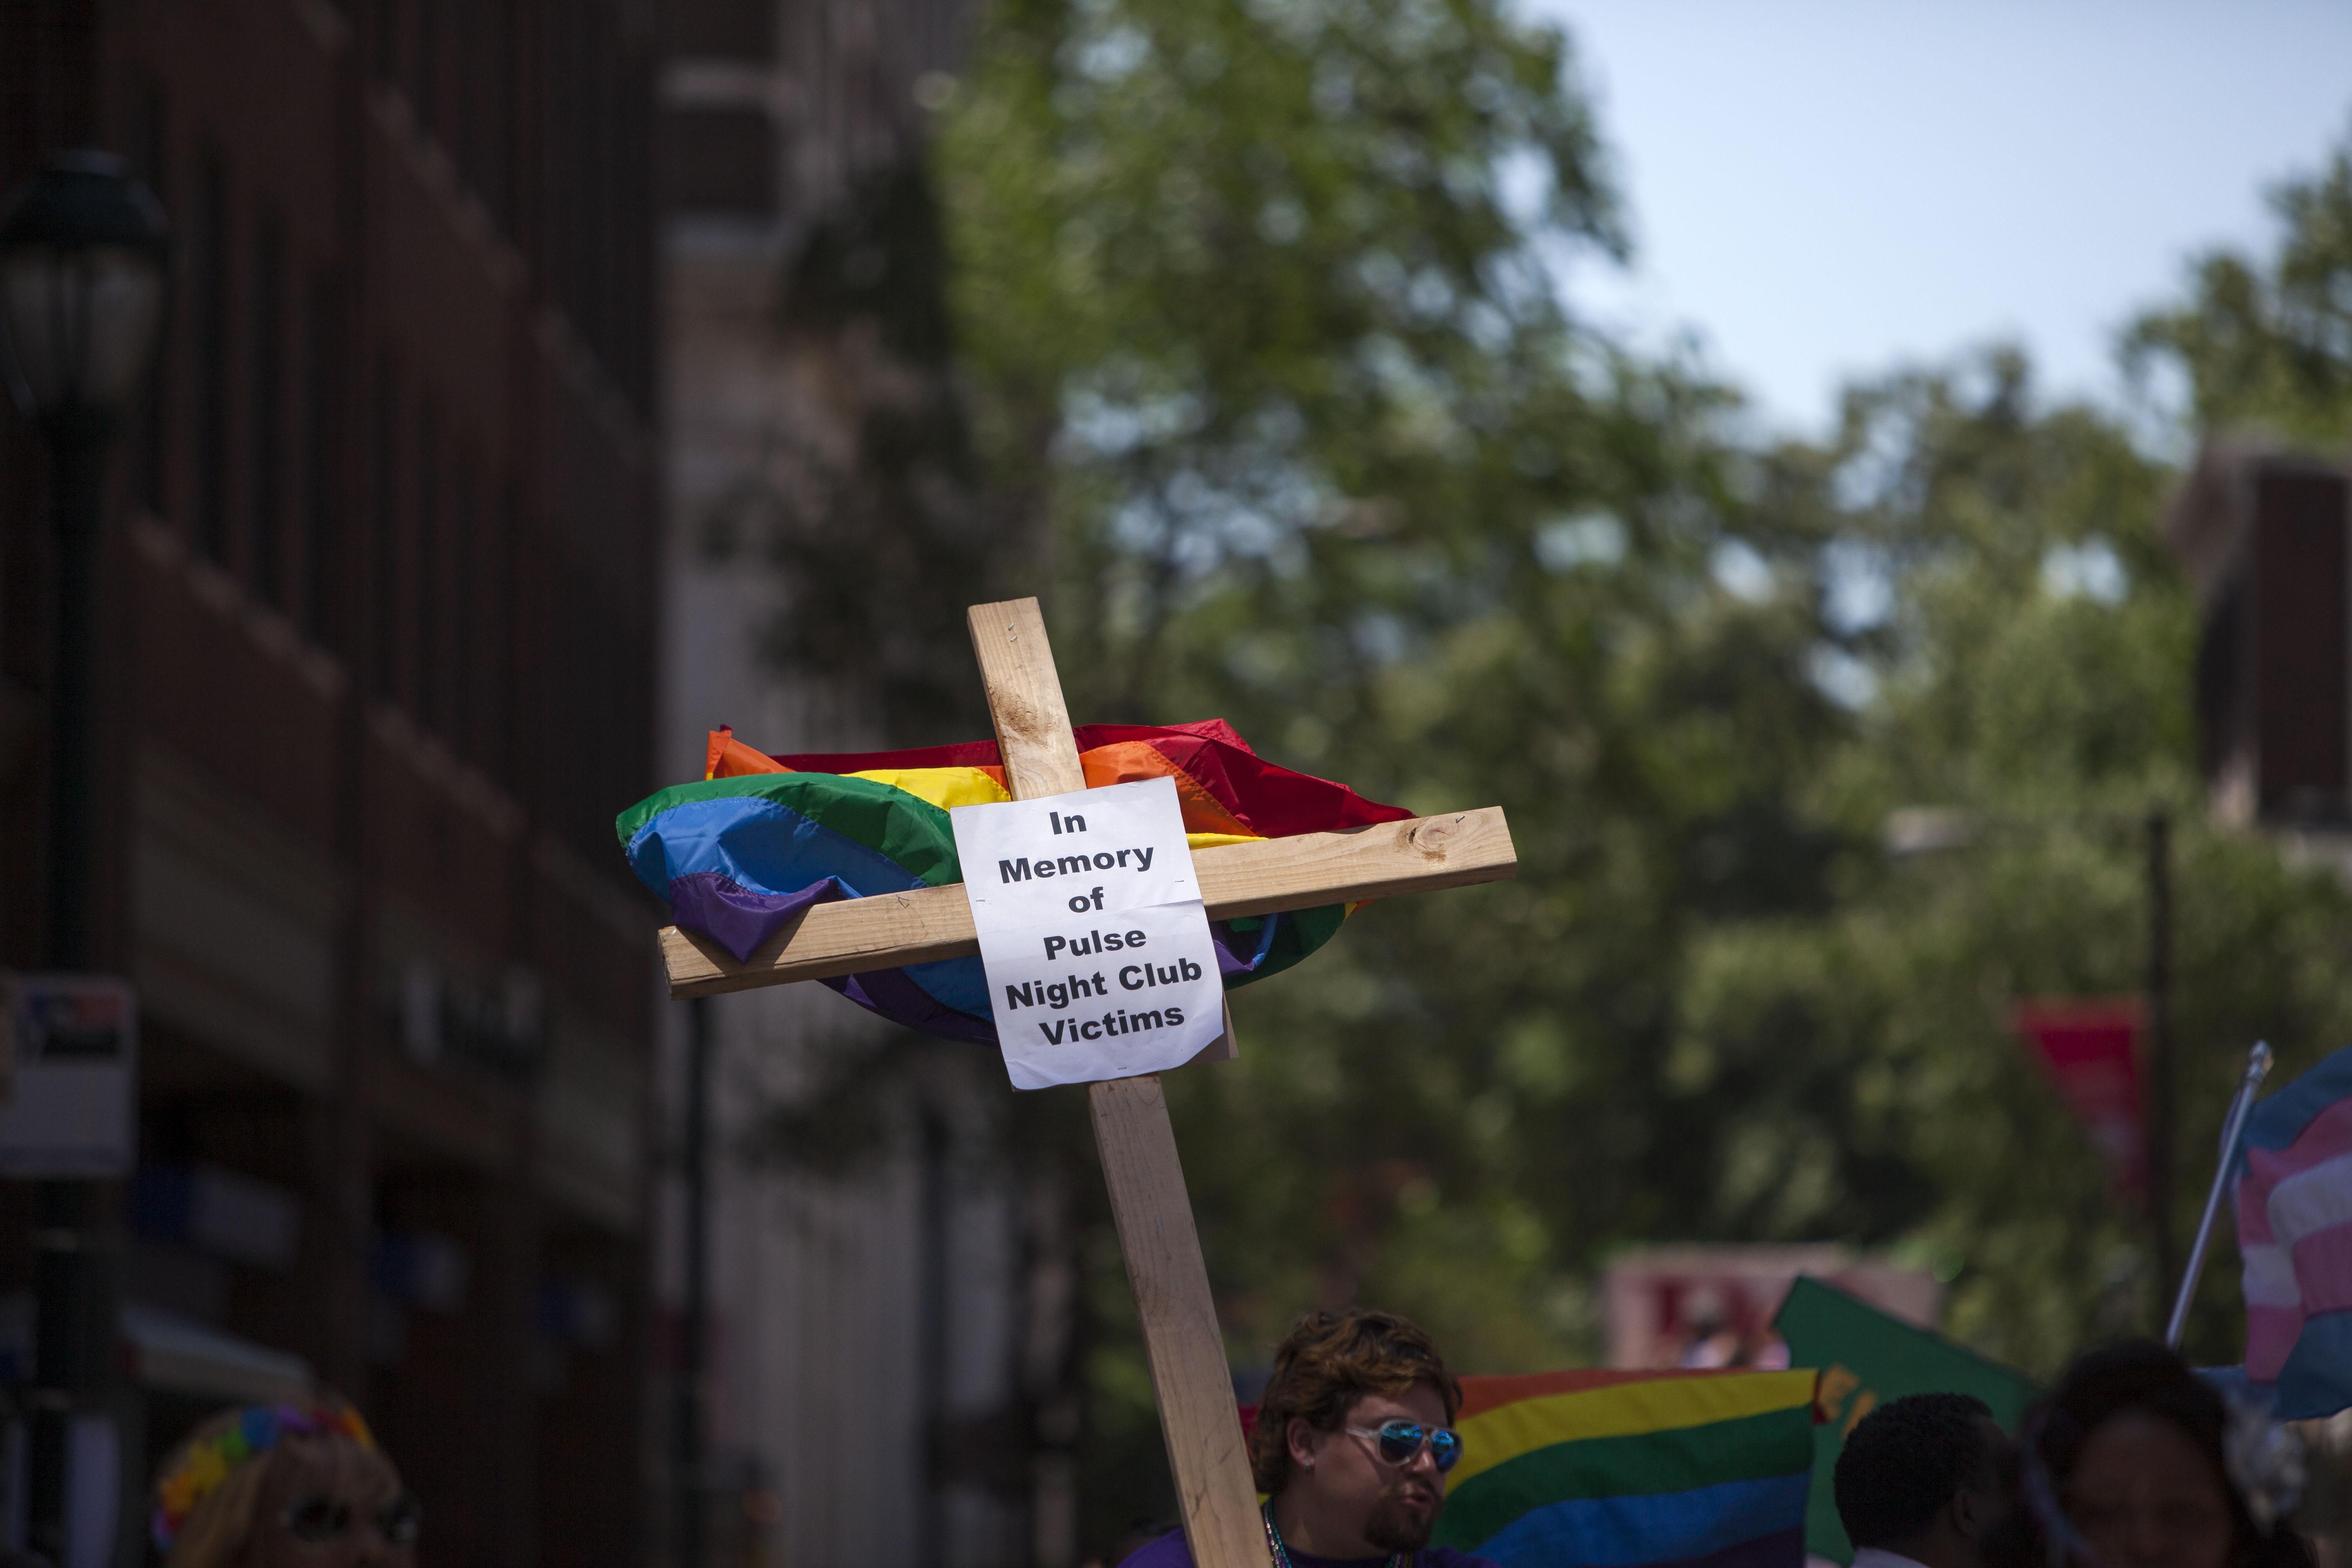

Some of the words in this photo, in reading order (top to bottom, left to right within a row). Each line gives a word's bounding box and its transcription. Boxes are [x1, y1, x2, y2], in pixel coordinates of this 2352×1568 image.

[1050, 812, 1087, 835] In
[998, 847, 1153, 884] Memory
[1068, 887, 1104, 913] of
[1043, 930, 1146, 961] Pulse
[1005, 971, 1108, 1011] Night
[1119, 958, 1202, 990] Club
[1038, 1007, 1185, 1046] Victims
